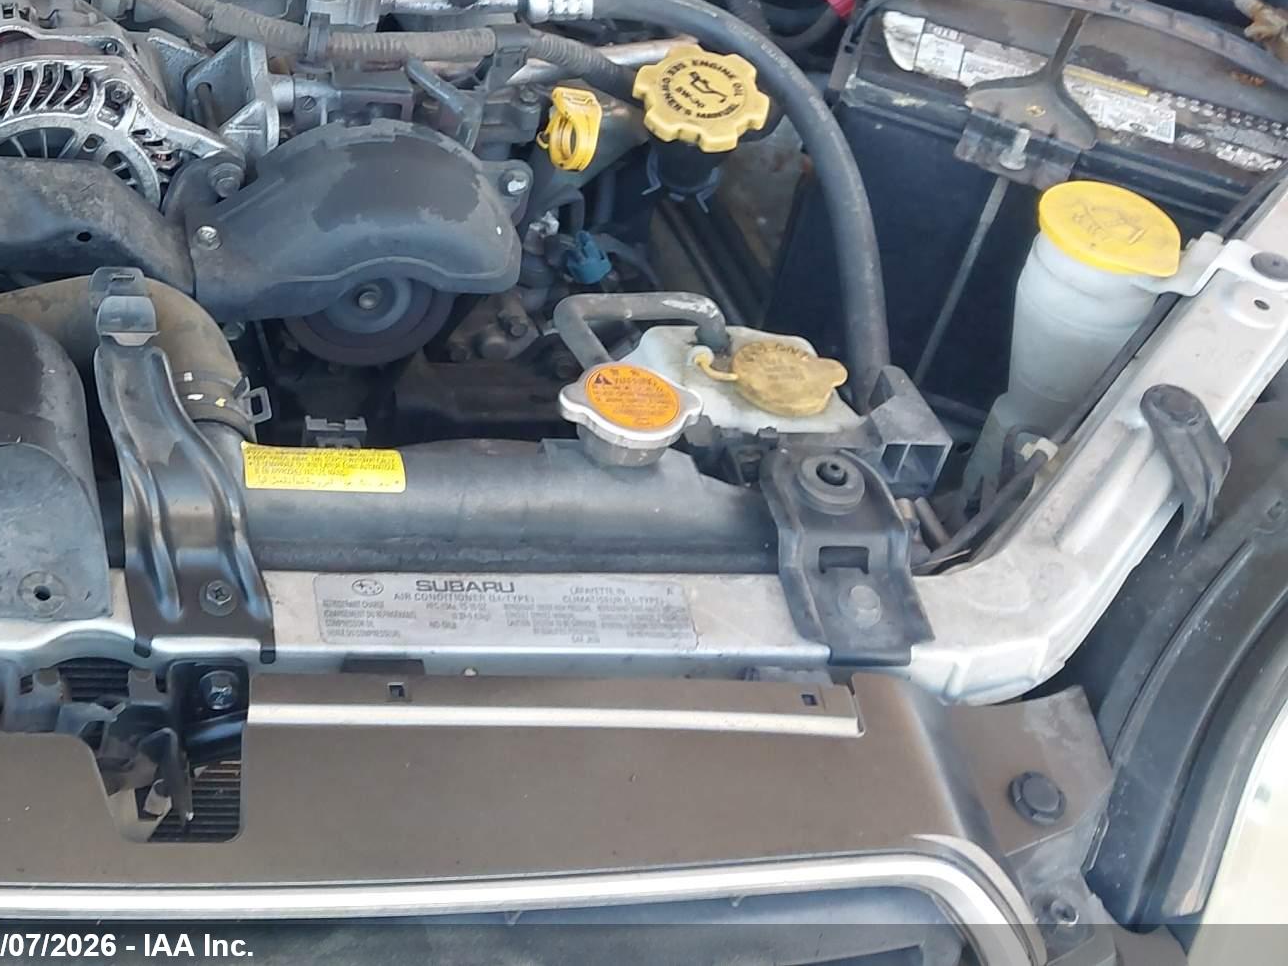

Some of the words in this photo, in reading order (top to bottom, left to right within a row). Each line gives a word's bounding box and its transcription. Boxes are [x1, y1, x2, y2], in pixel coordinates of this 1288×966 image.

[667, 62, 688, 76] SEE
[691, 59, 737, 79] ENGINE
[732, 82, 744, 97] OIL
[661, 77, 692, 116] OWNER'S
[675, 86, 706, 108] 5W-30
[696, 104, 740, 119] MANUAL
[415, 579, 515, 594] SUBARU
[393, 593, 412, 601] AIR
[414, 593, 485, 602] CONDITIONER
